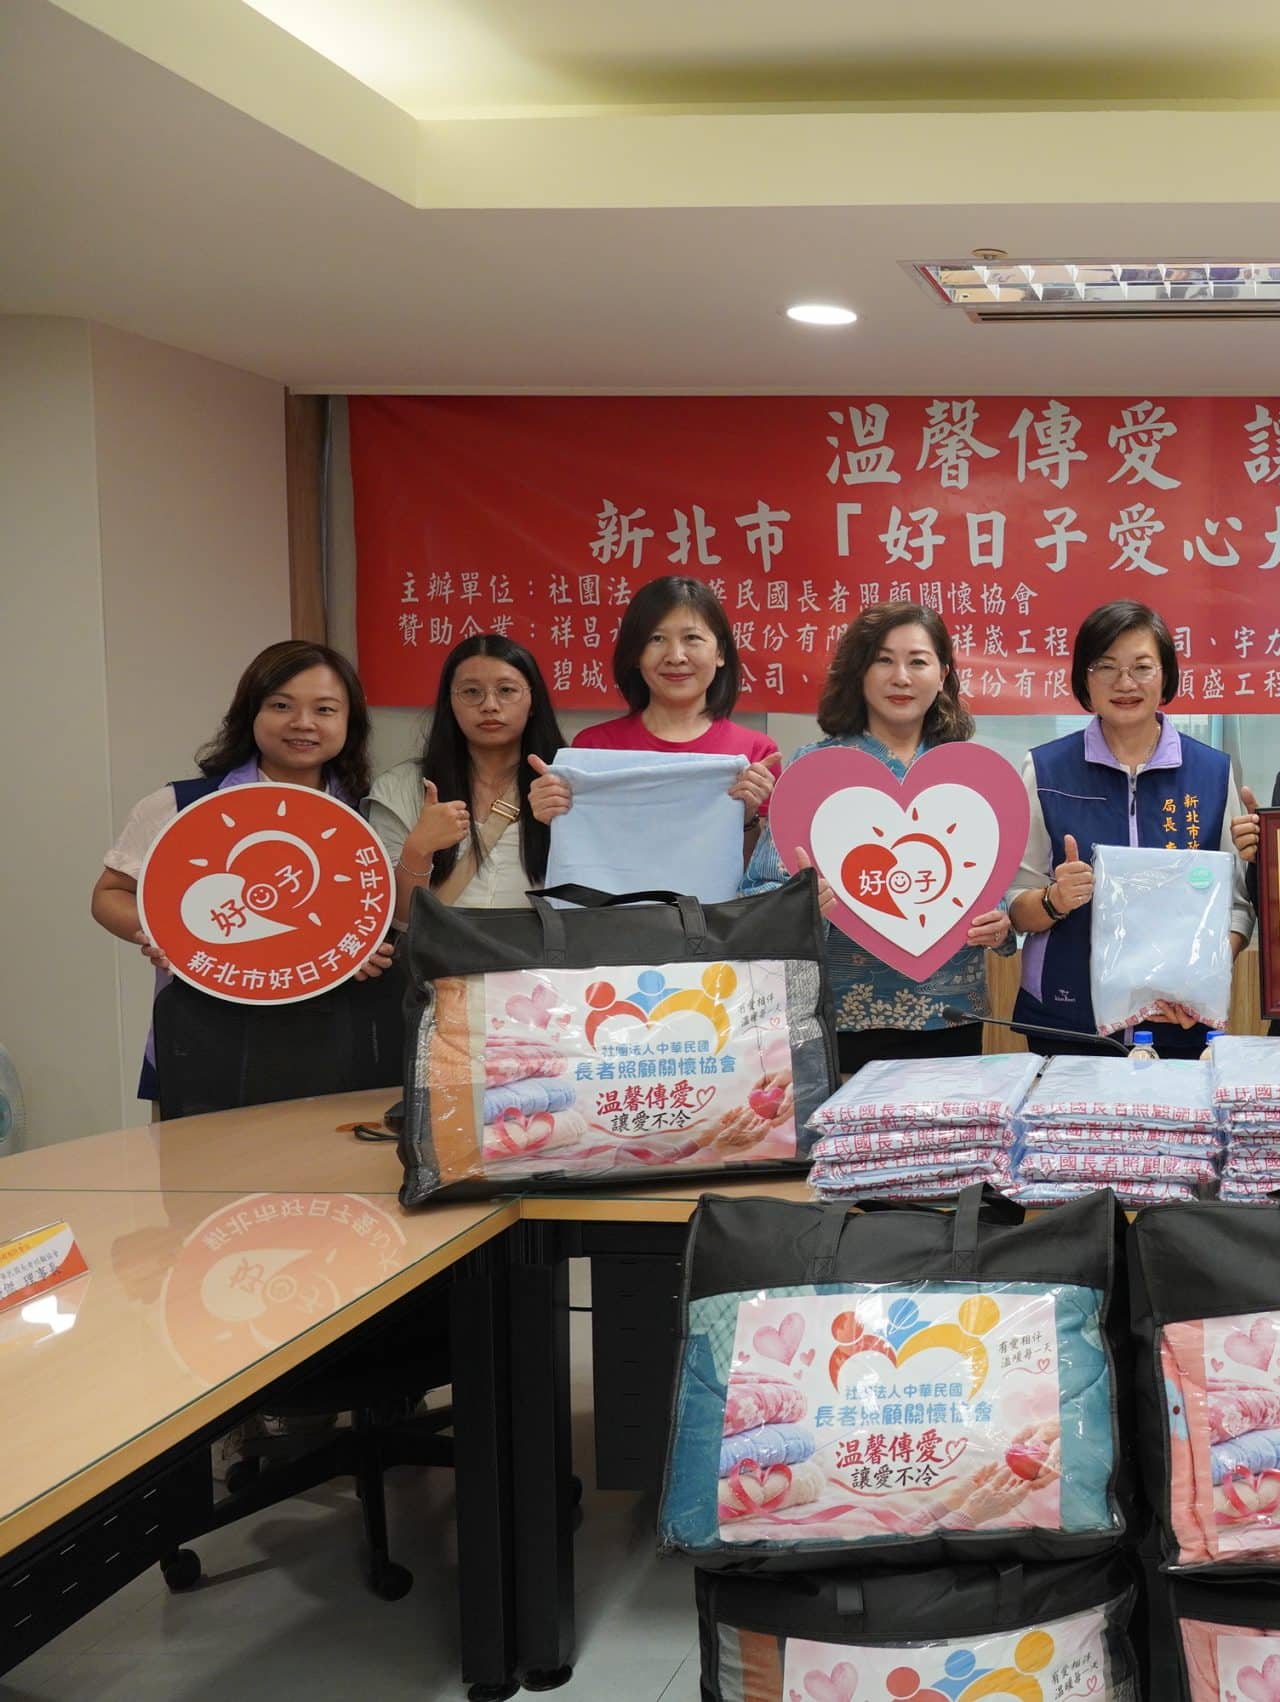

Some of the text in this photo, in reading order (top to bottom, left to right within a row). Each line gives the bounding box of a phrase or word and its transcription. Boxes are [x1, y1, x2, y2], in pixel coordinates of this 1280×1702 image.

[825, 398, 1182, 491] 溫馨傳愛
[1162, 799, 1177, 832] 局長
[186, 845, 385, 991] 新北市好日子愛心大平台
[574, 1054, 737, 1081] 長者照顧關懷協會
[610, 1109, 692, 1133] 讓愛不冷
[850, 1463, 940, 1490] 讓愛不冷
